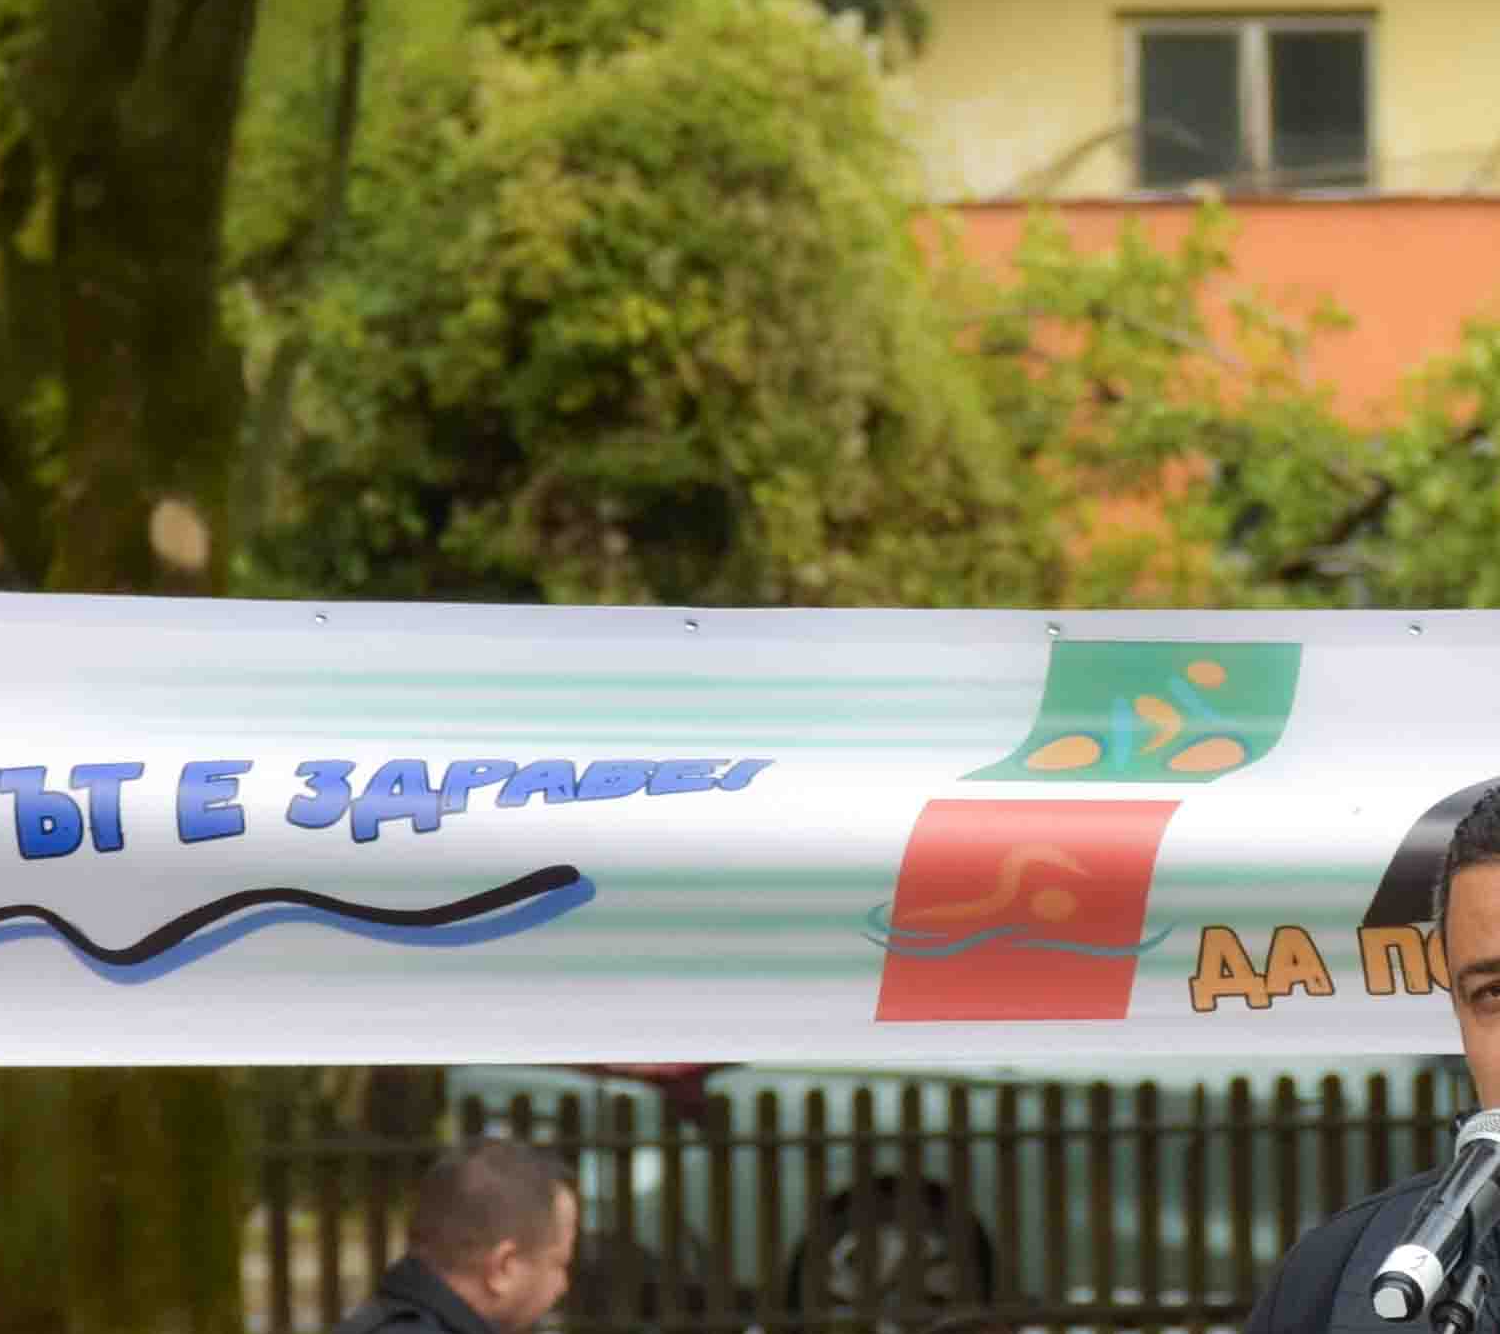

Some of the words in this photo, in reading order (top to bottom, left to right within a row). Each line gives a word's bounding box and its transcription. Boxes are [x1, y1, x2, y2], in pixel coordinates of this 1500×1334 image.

[176, 759, 254, 845] Е
[285, 758, 777, 845] ЗДРАВЕ!
[1188, 924, 1336, 1013] ДА
